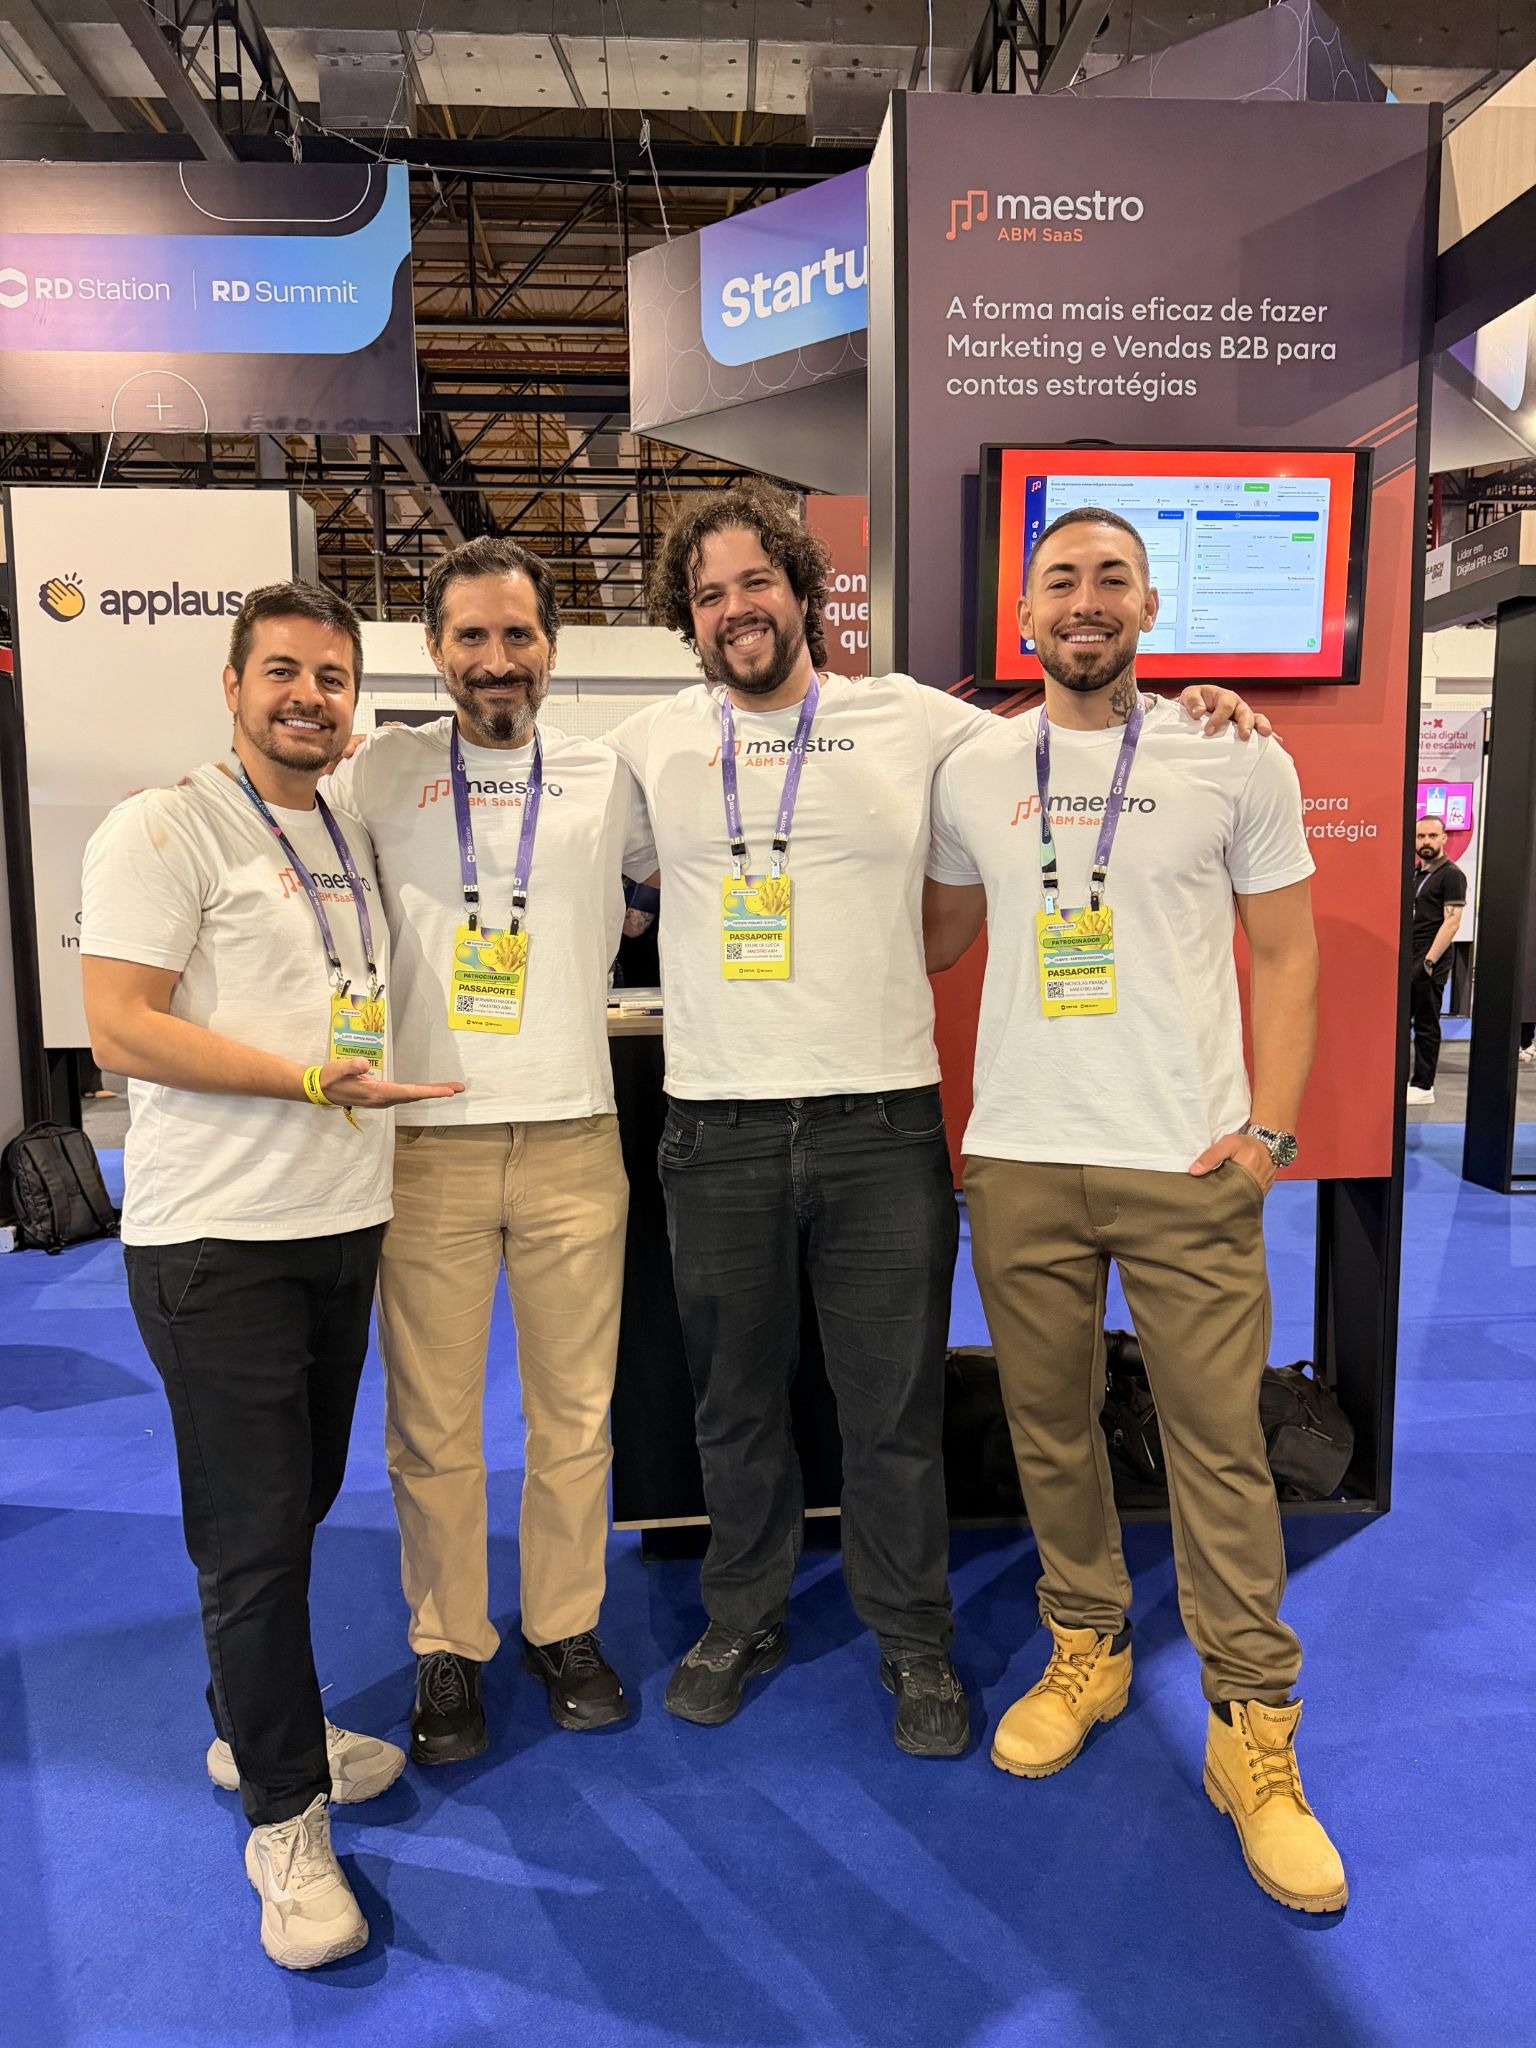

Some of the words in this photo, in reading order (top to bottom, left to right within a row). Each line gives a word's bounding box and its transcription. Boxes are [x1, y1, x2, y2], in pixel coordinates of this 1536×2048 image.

[997, 190, 1144, 222] maestro
[997, 228, 1037, 242] ABM
[1042, 228, 1083, 242] SaaS
[35, 278, 73, 299] RD
[78, 278, 170, 301] Station
[212, 281, 250, 302] RD
[255, 280, 358, 304] Summit
[721, 245, 868, 328] Startu
[946, 297, 967, 319] A
[973, 296, 1053, 320] forma
[1062, 297, 1124, 321] mais
[1131, 297, 1213, 321] eficaz
[1220, 298, 1253, 322] de
[1259, 298, 1328, 322] fazer
[947, 334, 1083, 364] Marketing
[1091, 342, 1106, 359] e
[1113, 335, 1212, 359] Vendas
[1220, 337, 1269, 360] B2B
[1277, 340, 1336, 365] para
[946, 373, 1039, 396] contas
[1046, 372, 1198, 401] estratégias
[1473, 544, 1484, 555] em
[1456, 560, 1476, 577] Digital
[1476, 556, 1486, 568] PR
[1487, 555, 1492, 563] e
[1493, 546, 1509, 561] SEO
[100, 581, 244, 625] applaus
[824, 602, 868, 627] que
[1438, 731, 1468, 741] digital
[1433, 740, 1476, 750] escalável
[745, 758, 774, 767] ABM
[778, 757, 809, 766] SS
[466, 780, 563, 797] maesro
[468, 797, 487, 806] BM
[492, 797, 522, 807] SaaS
[1047, 796, 1156, 813] maetro
[1303, 797, 1349, 815] para
[1048, 815, 1074, 825] ABM
[1078, 816, 1104, 826] Saa
[1305, 820, 1377, 842] ratégia
[319, 892, 333, 902] BM
[334, 893, 356, 903] SaaS
[729, 933, 783, 941] PASSAPORTE
[1051, 937, 1100, 946] PATROCINADOR
[463, 973, 511, 981] PATROCINADOR
[1047, 966, 1107, 977] PASSAPORTE
[458, 984, 516, 996] PASSAPORTE
[342, 1047, 377, 1057] PATROCINADOR
